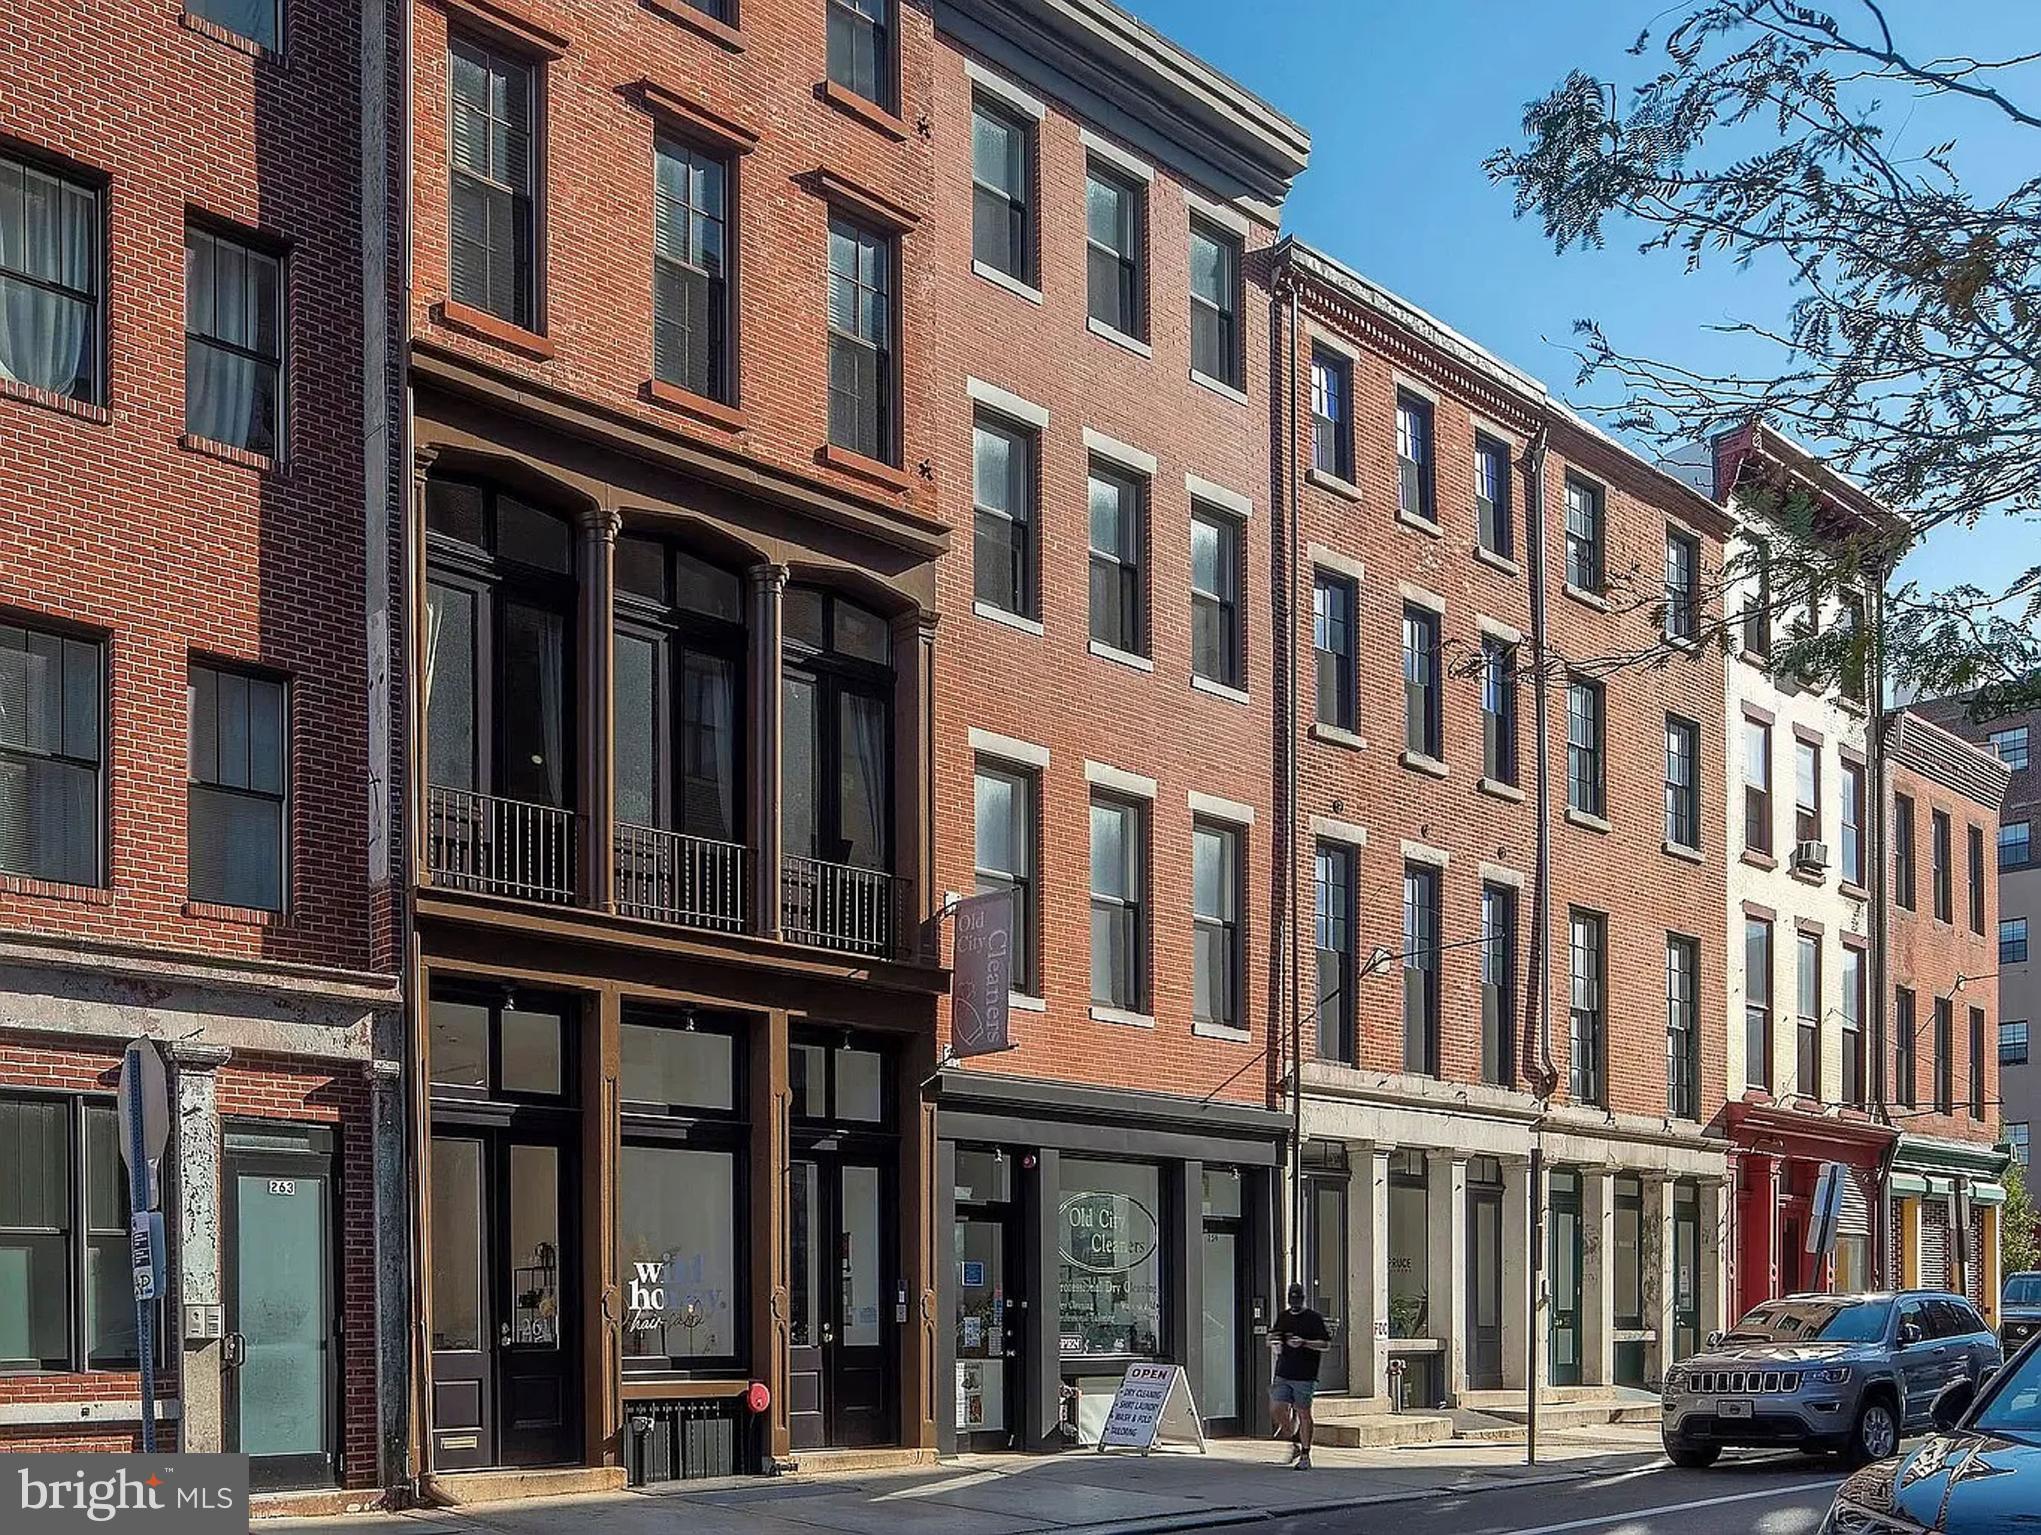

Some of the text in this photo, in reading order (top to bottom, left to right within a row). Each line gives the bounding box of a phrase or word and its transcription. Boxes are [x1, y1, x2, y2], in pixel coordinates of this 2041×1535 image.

[959, 911, 985, 931] Old
[958, 935, 986, 953] City
[986, 930, 1008, 1042] Cleaners
[271, 1181, 294, 1194] 263
[1069, 1207, 1125, 1232] Old City
[1091, 1233, 1145, 1253] Cleaners
[1059, 1338, 1080, 1349] PEN
[1131, 1368, 1168, 1380] OPEN
[1123, 1388, 1136, 1397] DRY
[1114, 1413, 1131, 1421] WASH
[1137, 1414, 1153, 1424] FOLD
